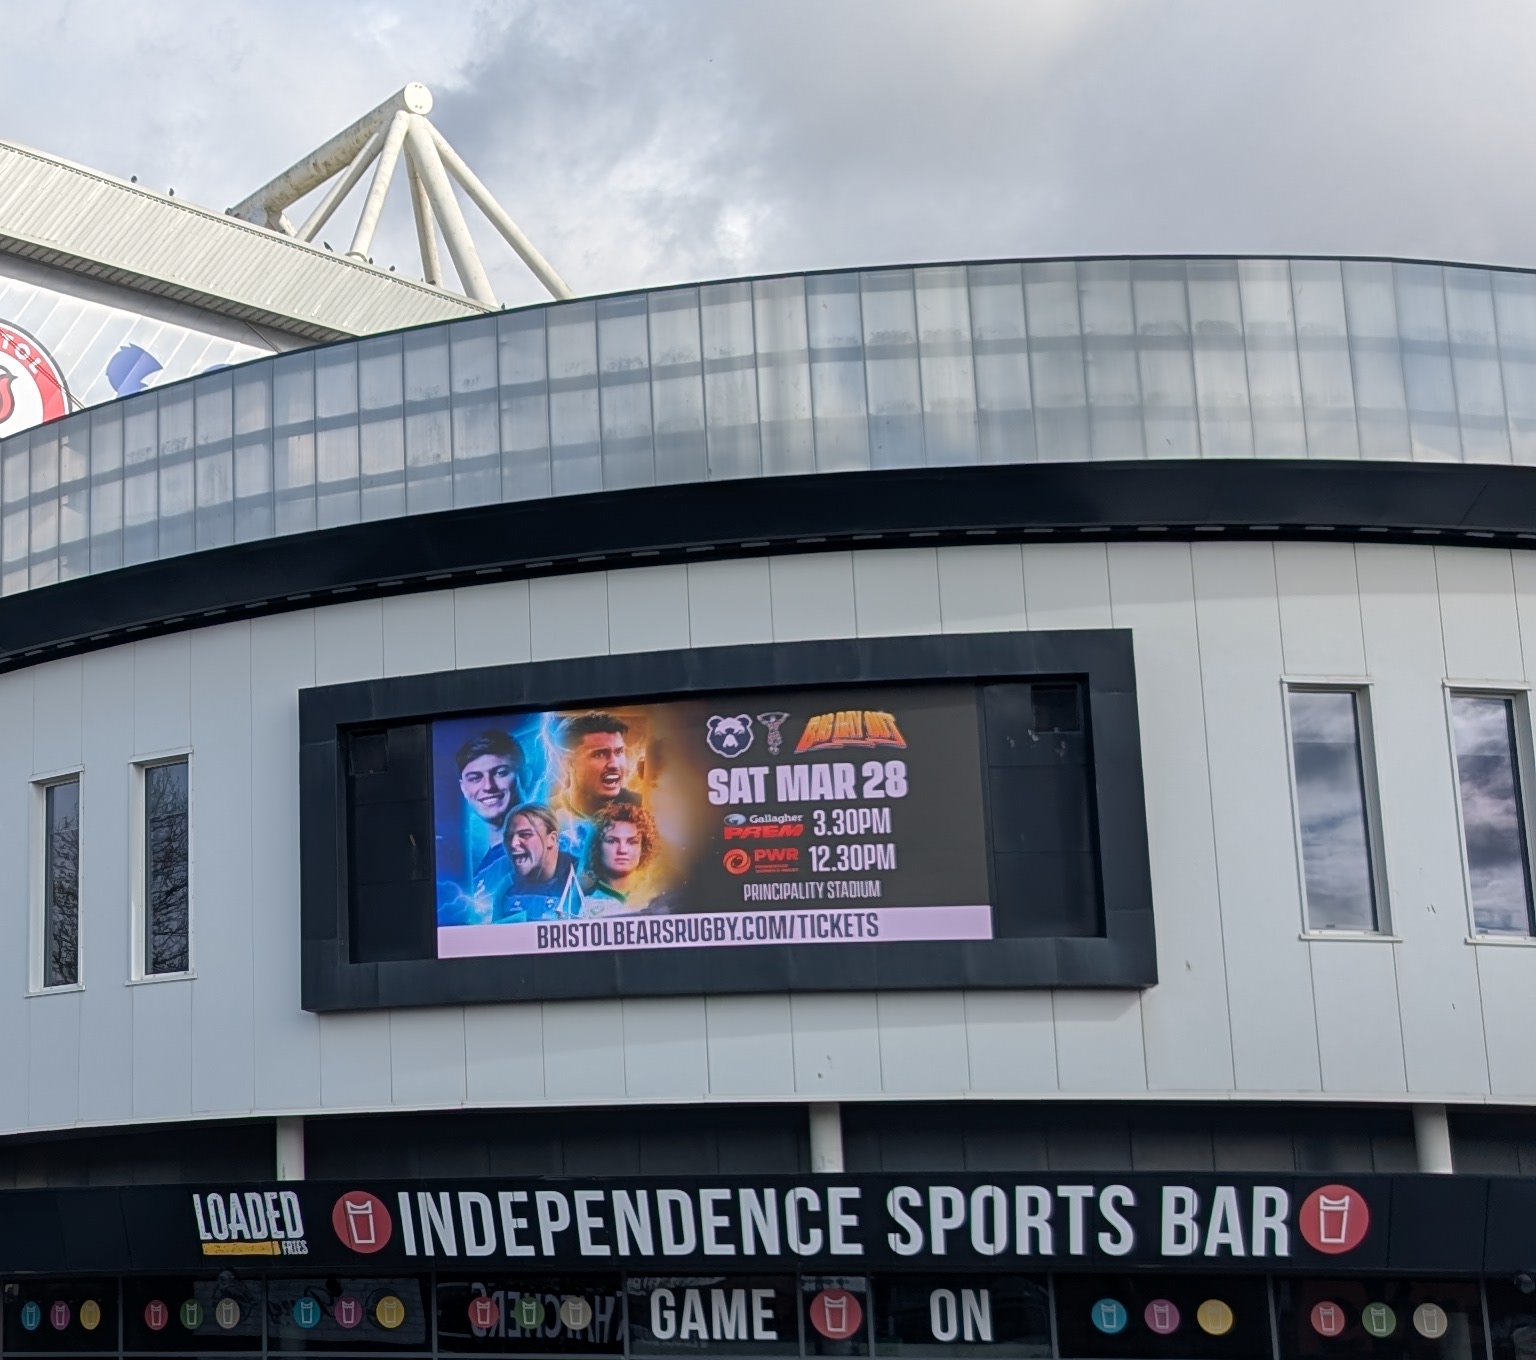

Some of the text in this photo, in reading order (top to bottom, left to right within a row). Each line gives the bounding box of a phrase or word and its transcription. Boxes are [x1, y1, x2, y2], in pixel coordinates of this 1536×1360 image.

[707, 760, 908, 805] SAT MAR 28
[723, 824, 804, 840] PREM
[749, 813, 804, 825] Gallagher
[813, 807, 892, 836] 3.30PM
[754, 847, 799, 862] PWR
[808, 843, 897, 872] 12.30PM
[743, 880, 882, 902] PRINCIPALITY STADIUM
[537, 913, 879, 949] BRISTOLBEARSRUGBY.COM/TICKETS
[192, 1191, 304, 1240] LOADED
[397, 1184, 1290, 1257] INDEPENDENCE SPORTS BAR
[282, 1240, 309, 1255] FRIES
[651, 1288, 993, 1341] GAME ON
